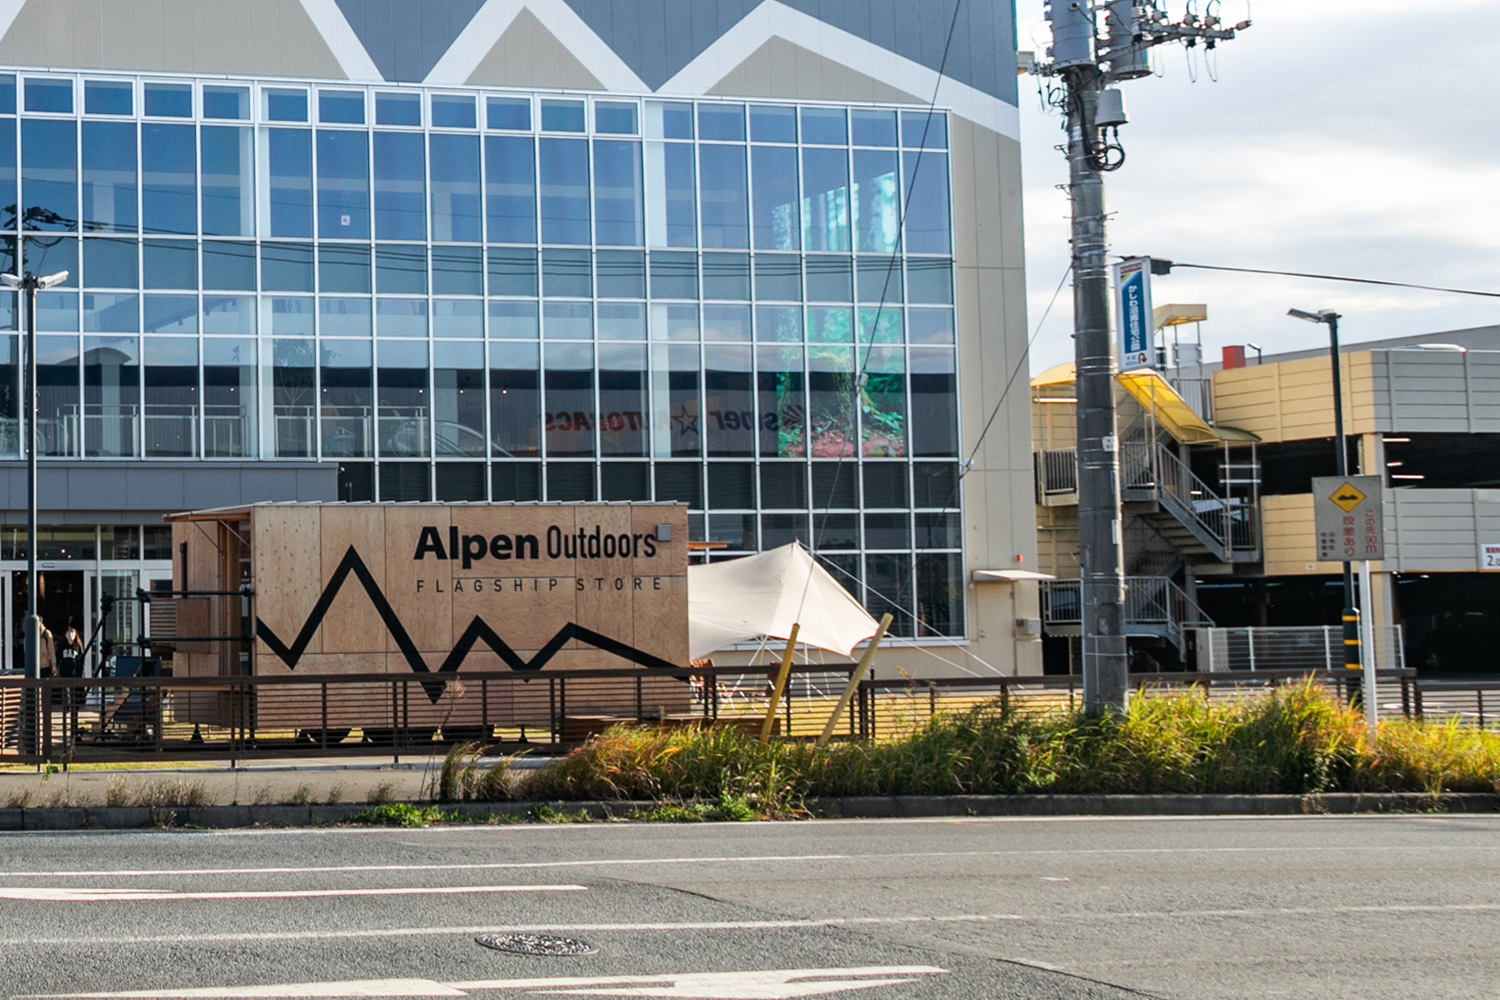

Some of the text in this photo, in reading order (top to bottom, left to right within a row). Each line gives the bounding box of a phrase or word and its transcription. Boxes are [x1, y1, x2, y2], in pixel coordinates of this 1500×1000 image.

[413, 525, 657, 569] Alpen Outdoors
[1342, 516, 1355, 557] 段差あり
[1365, 509, 1378, 554] この先90m
[417, 577, 661, 593] FLAGSHIP STORE
